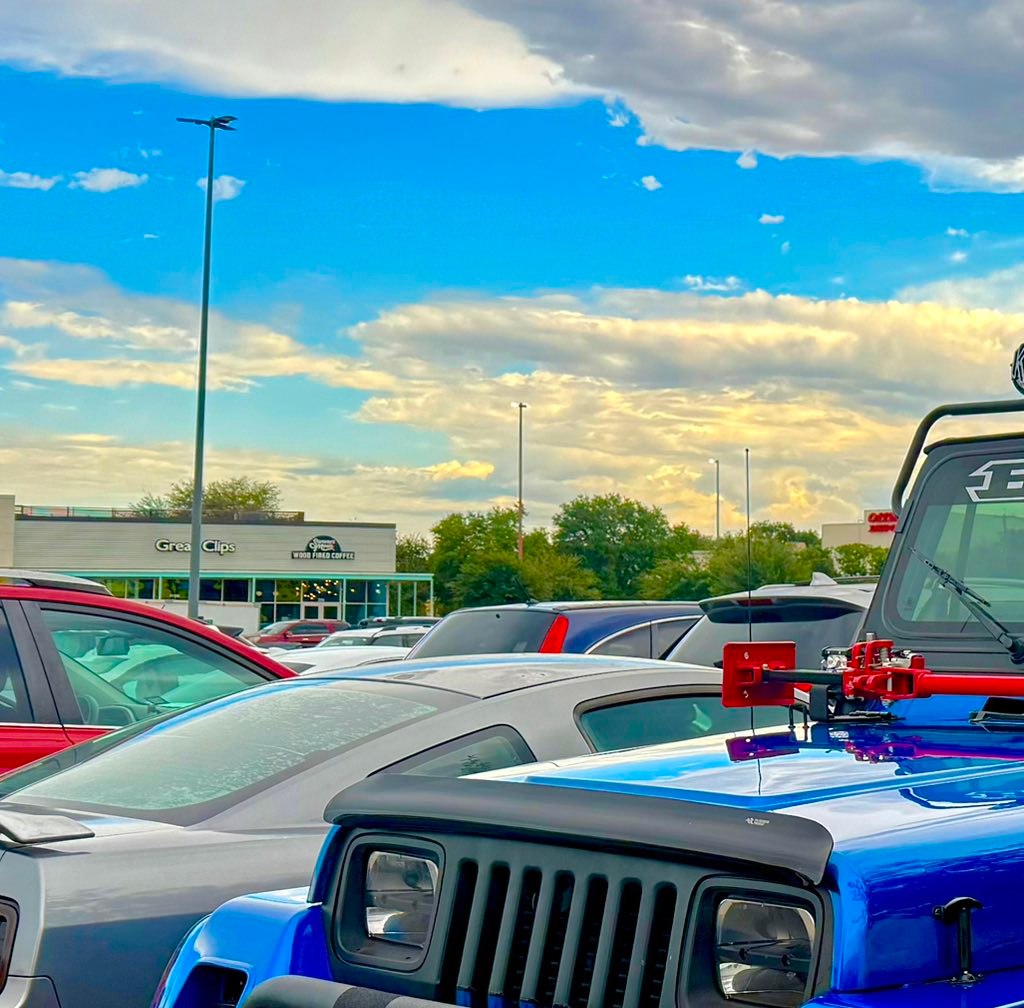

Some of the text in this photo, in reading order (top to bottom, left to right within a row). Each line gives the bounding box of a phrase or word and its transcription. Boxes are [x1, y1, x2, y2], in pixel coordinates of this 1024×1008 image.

[155, 539, 236, 555] Grea Clips
[293, 551, 354, 560] WOOD FIRED COFFEE
